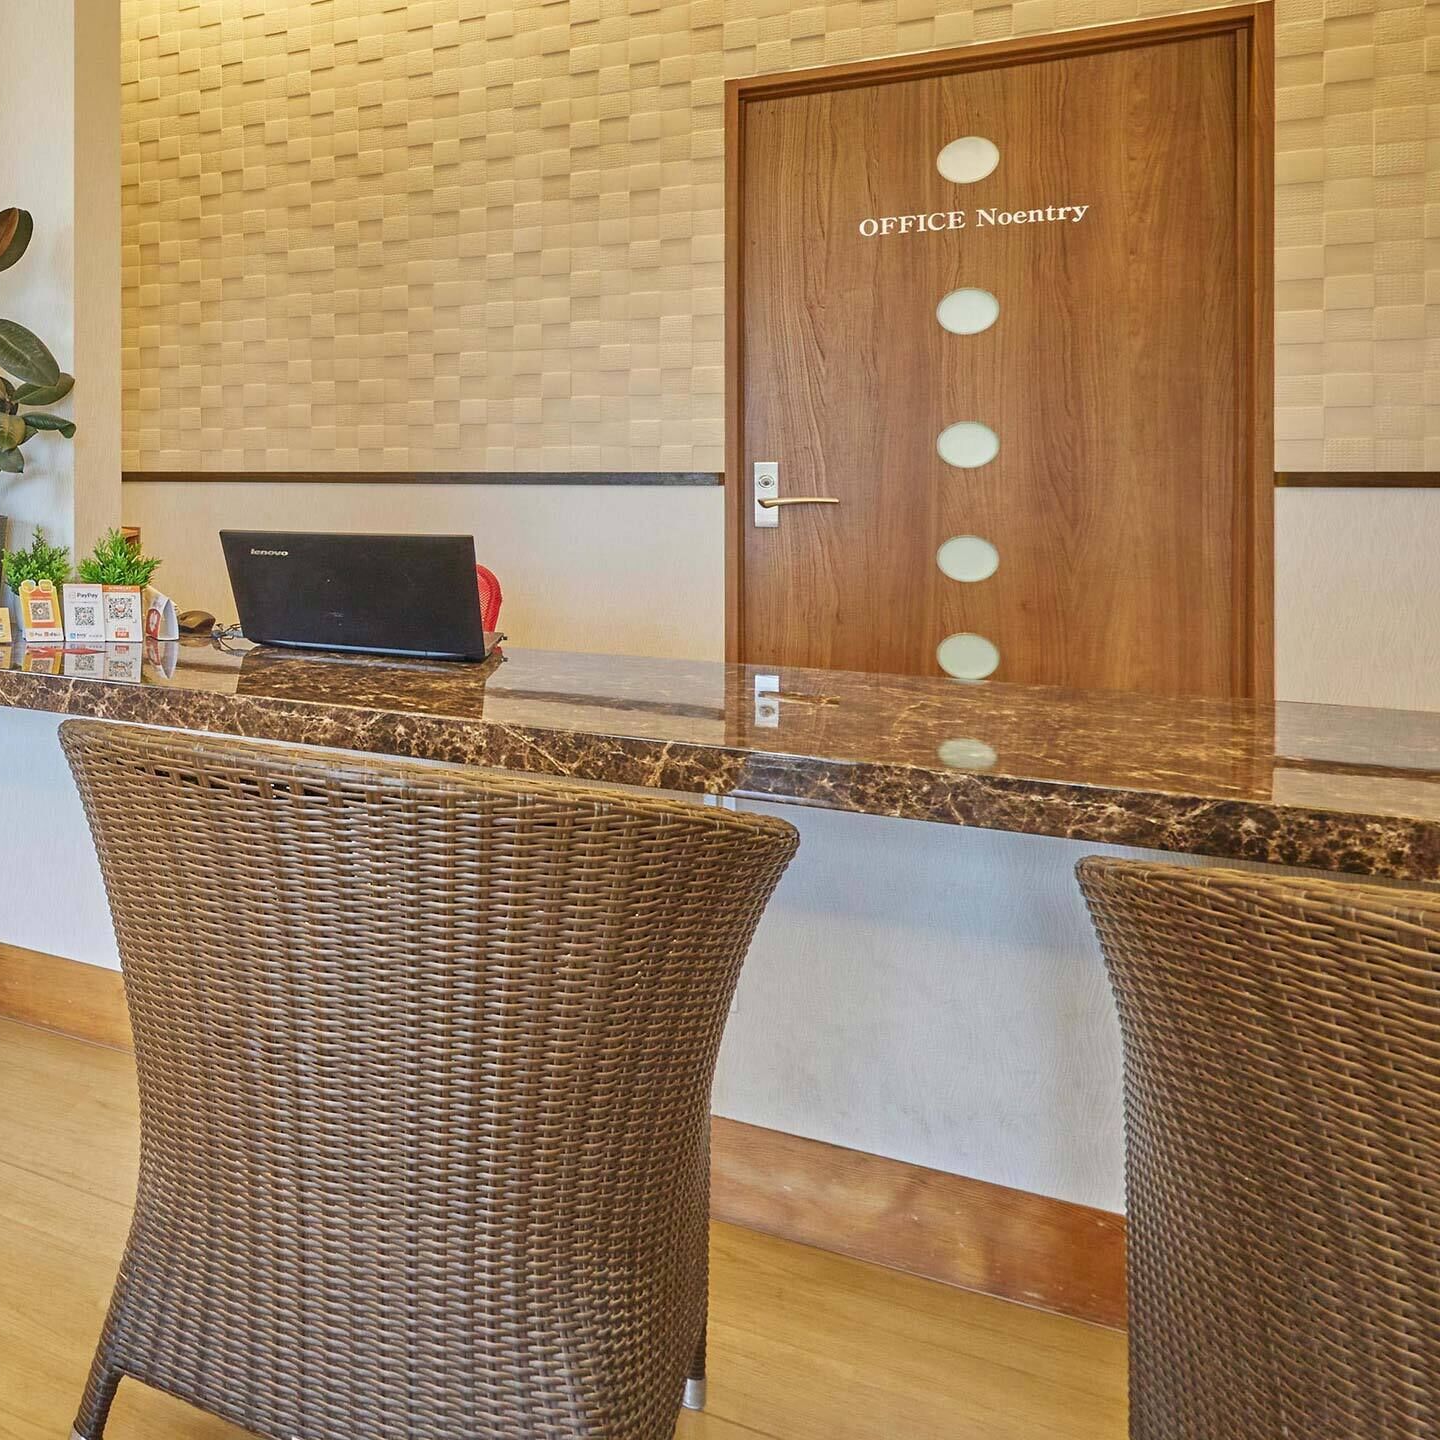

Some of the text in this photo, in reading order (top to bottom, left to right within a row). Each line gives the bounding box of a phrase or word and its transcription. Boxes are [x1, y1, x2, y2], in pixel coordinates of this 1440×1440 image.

[859, 205, 1090, 237] OFFICE Noentry
[250, 548, 289, 556] lenovo
[76, 592, 98, 600] PayPay
